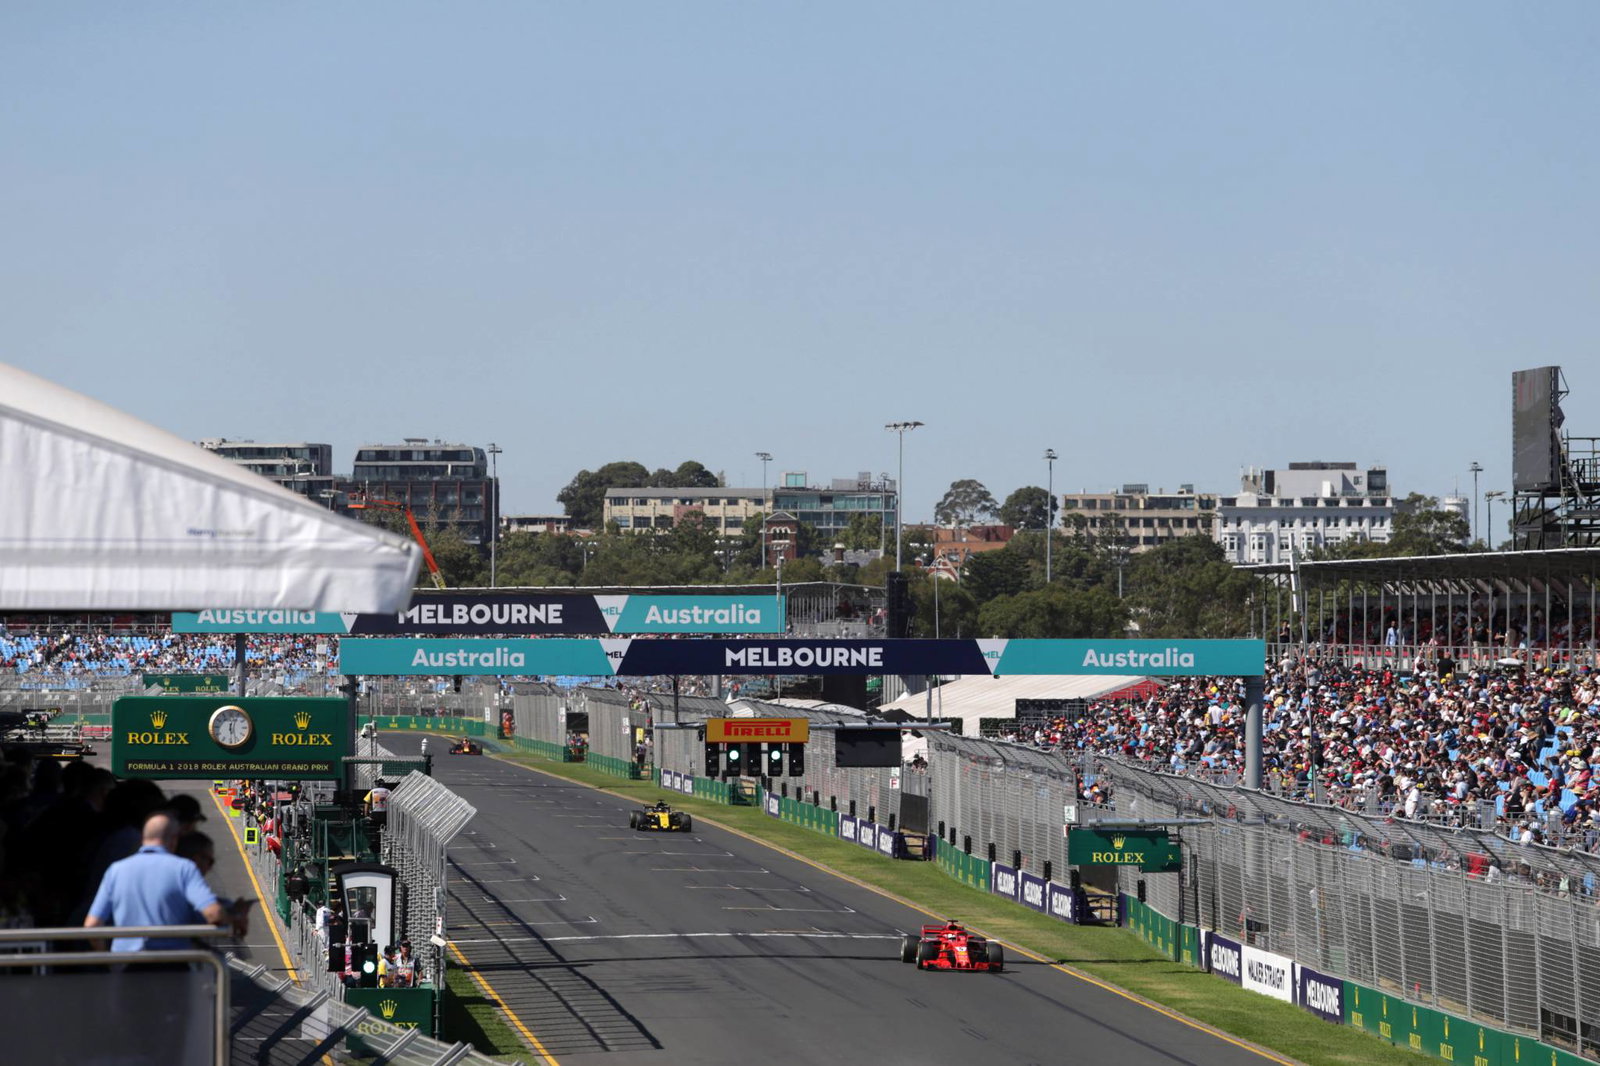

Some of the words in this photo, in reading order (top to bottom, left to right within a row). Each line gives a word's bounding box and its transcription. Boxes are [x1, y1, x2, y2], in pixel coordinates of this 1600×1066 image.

[198, 608, 315, 624] Australia
[398, 603, 563, 624] MELBOURNE
[601, 607, 621, 615] MEL
[644, 604, 760, 624] Australia
[411, 647, 525, 667] Australia
[606, 651, 624, 659] MEL
[725, 647, 883, 667] MELBOURNE
[1082, 648, 1195, 667] Australia
[724, 721, 791, 736] PIRELLI
[127, 732, 189, 745] ROLEX
[271, 733, 333, 746] ROLEX
[128, 763, 167, 771] FORMULA
[169, 763, 174, 771] 1
[177, 763, 199, 771] 2018
[201, 763, 227, 771] ROLEX
[229, 763, 279, 771] AUSTRALIAN
[281, 763, 309, 771] GRAND
[311, 763, 329, 771] PRIX
[1092, 852, 1145, 863] ROLEX
[1306, 978, 1340, 1016] MELBOURNE
